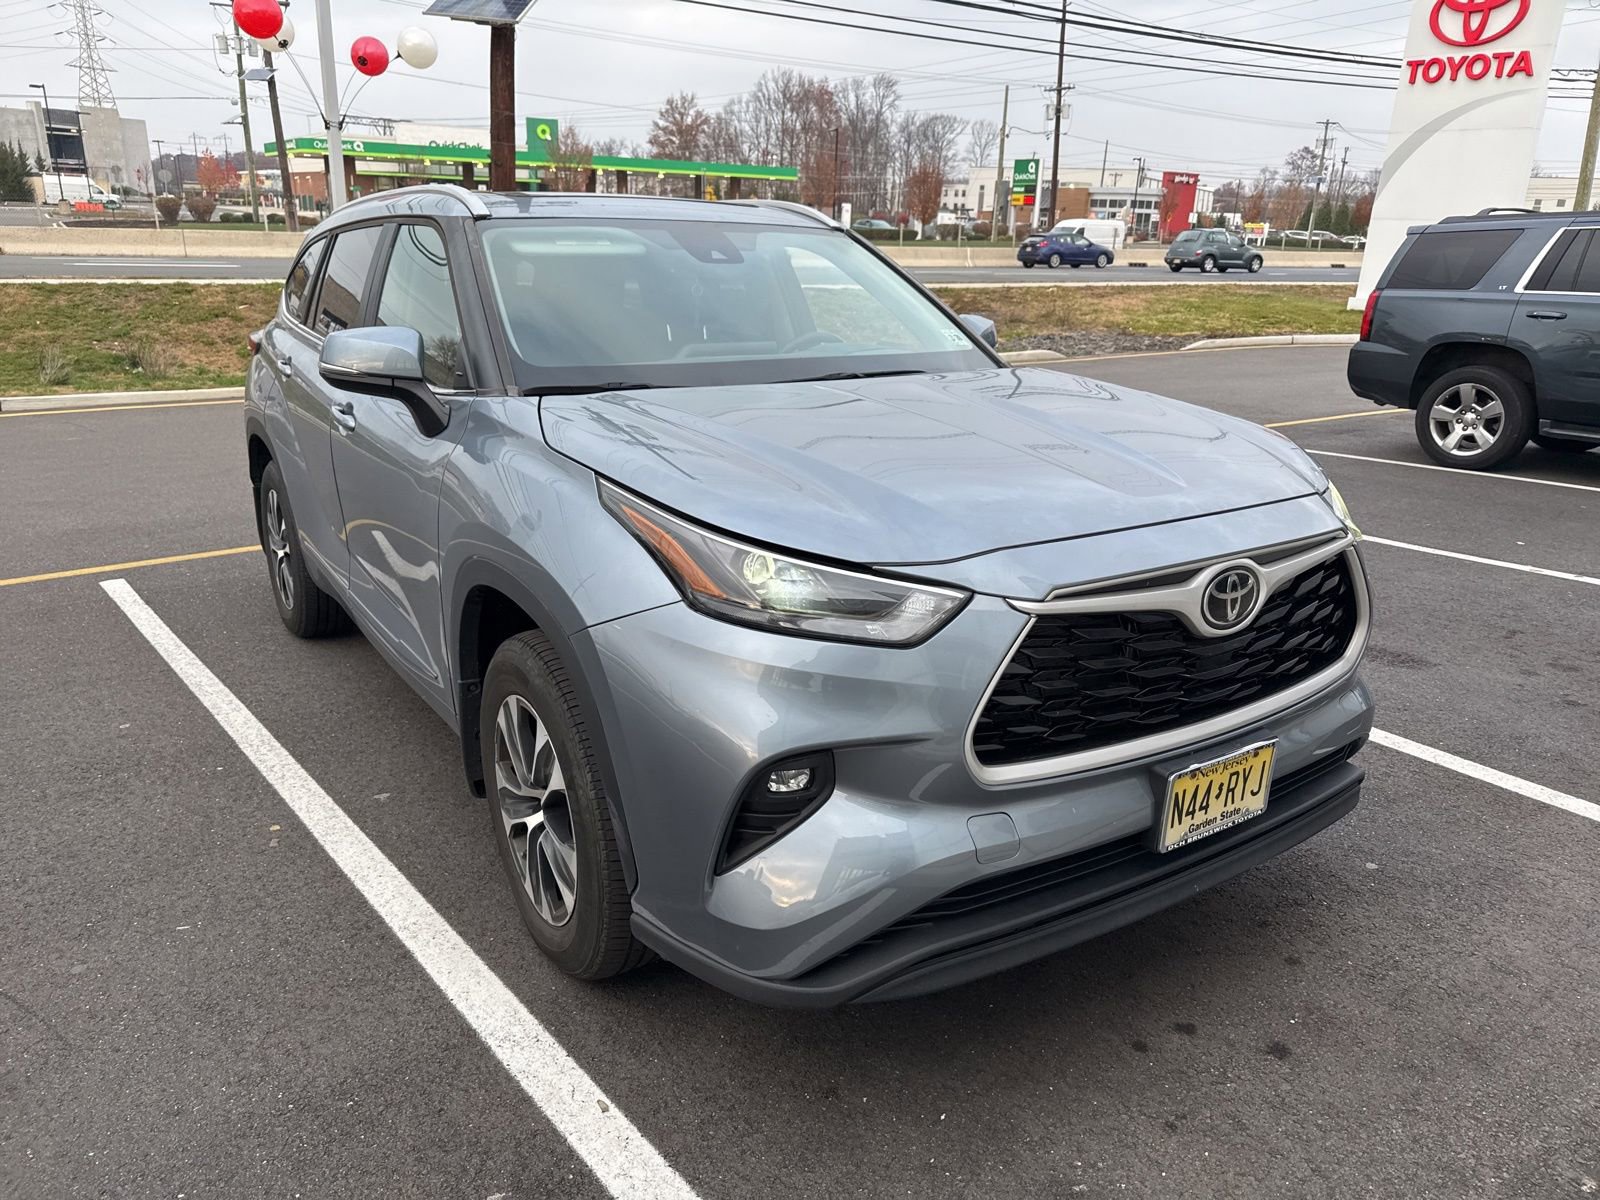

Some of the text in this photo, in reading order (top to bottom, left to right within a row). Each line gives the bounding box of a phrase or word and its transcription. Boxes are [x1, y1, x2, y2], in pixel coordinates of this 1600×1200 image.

[1407, 51, 1534, 85] TOYOTA
[313, 140, 353, 150] Quiek
[1196, 766, 1220, 780] New
[1219, 755, 1251, 775] Jersey
[1167, 809, 1262, 851] DCH BRUNSWICK TOYOTA
[1188, 807, 1242, 834] Garden State
